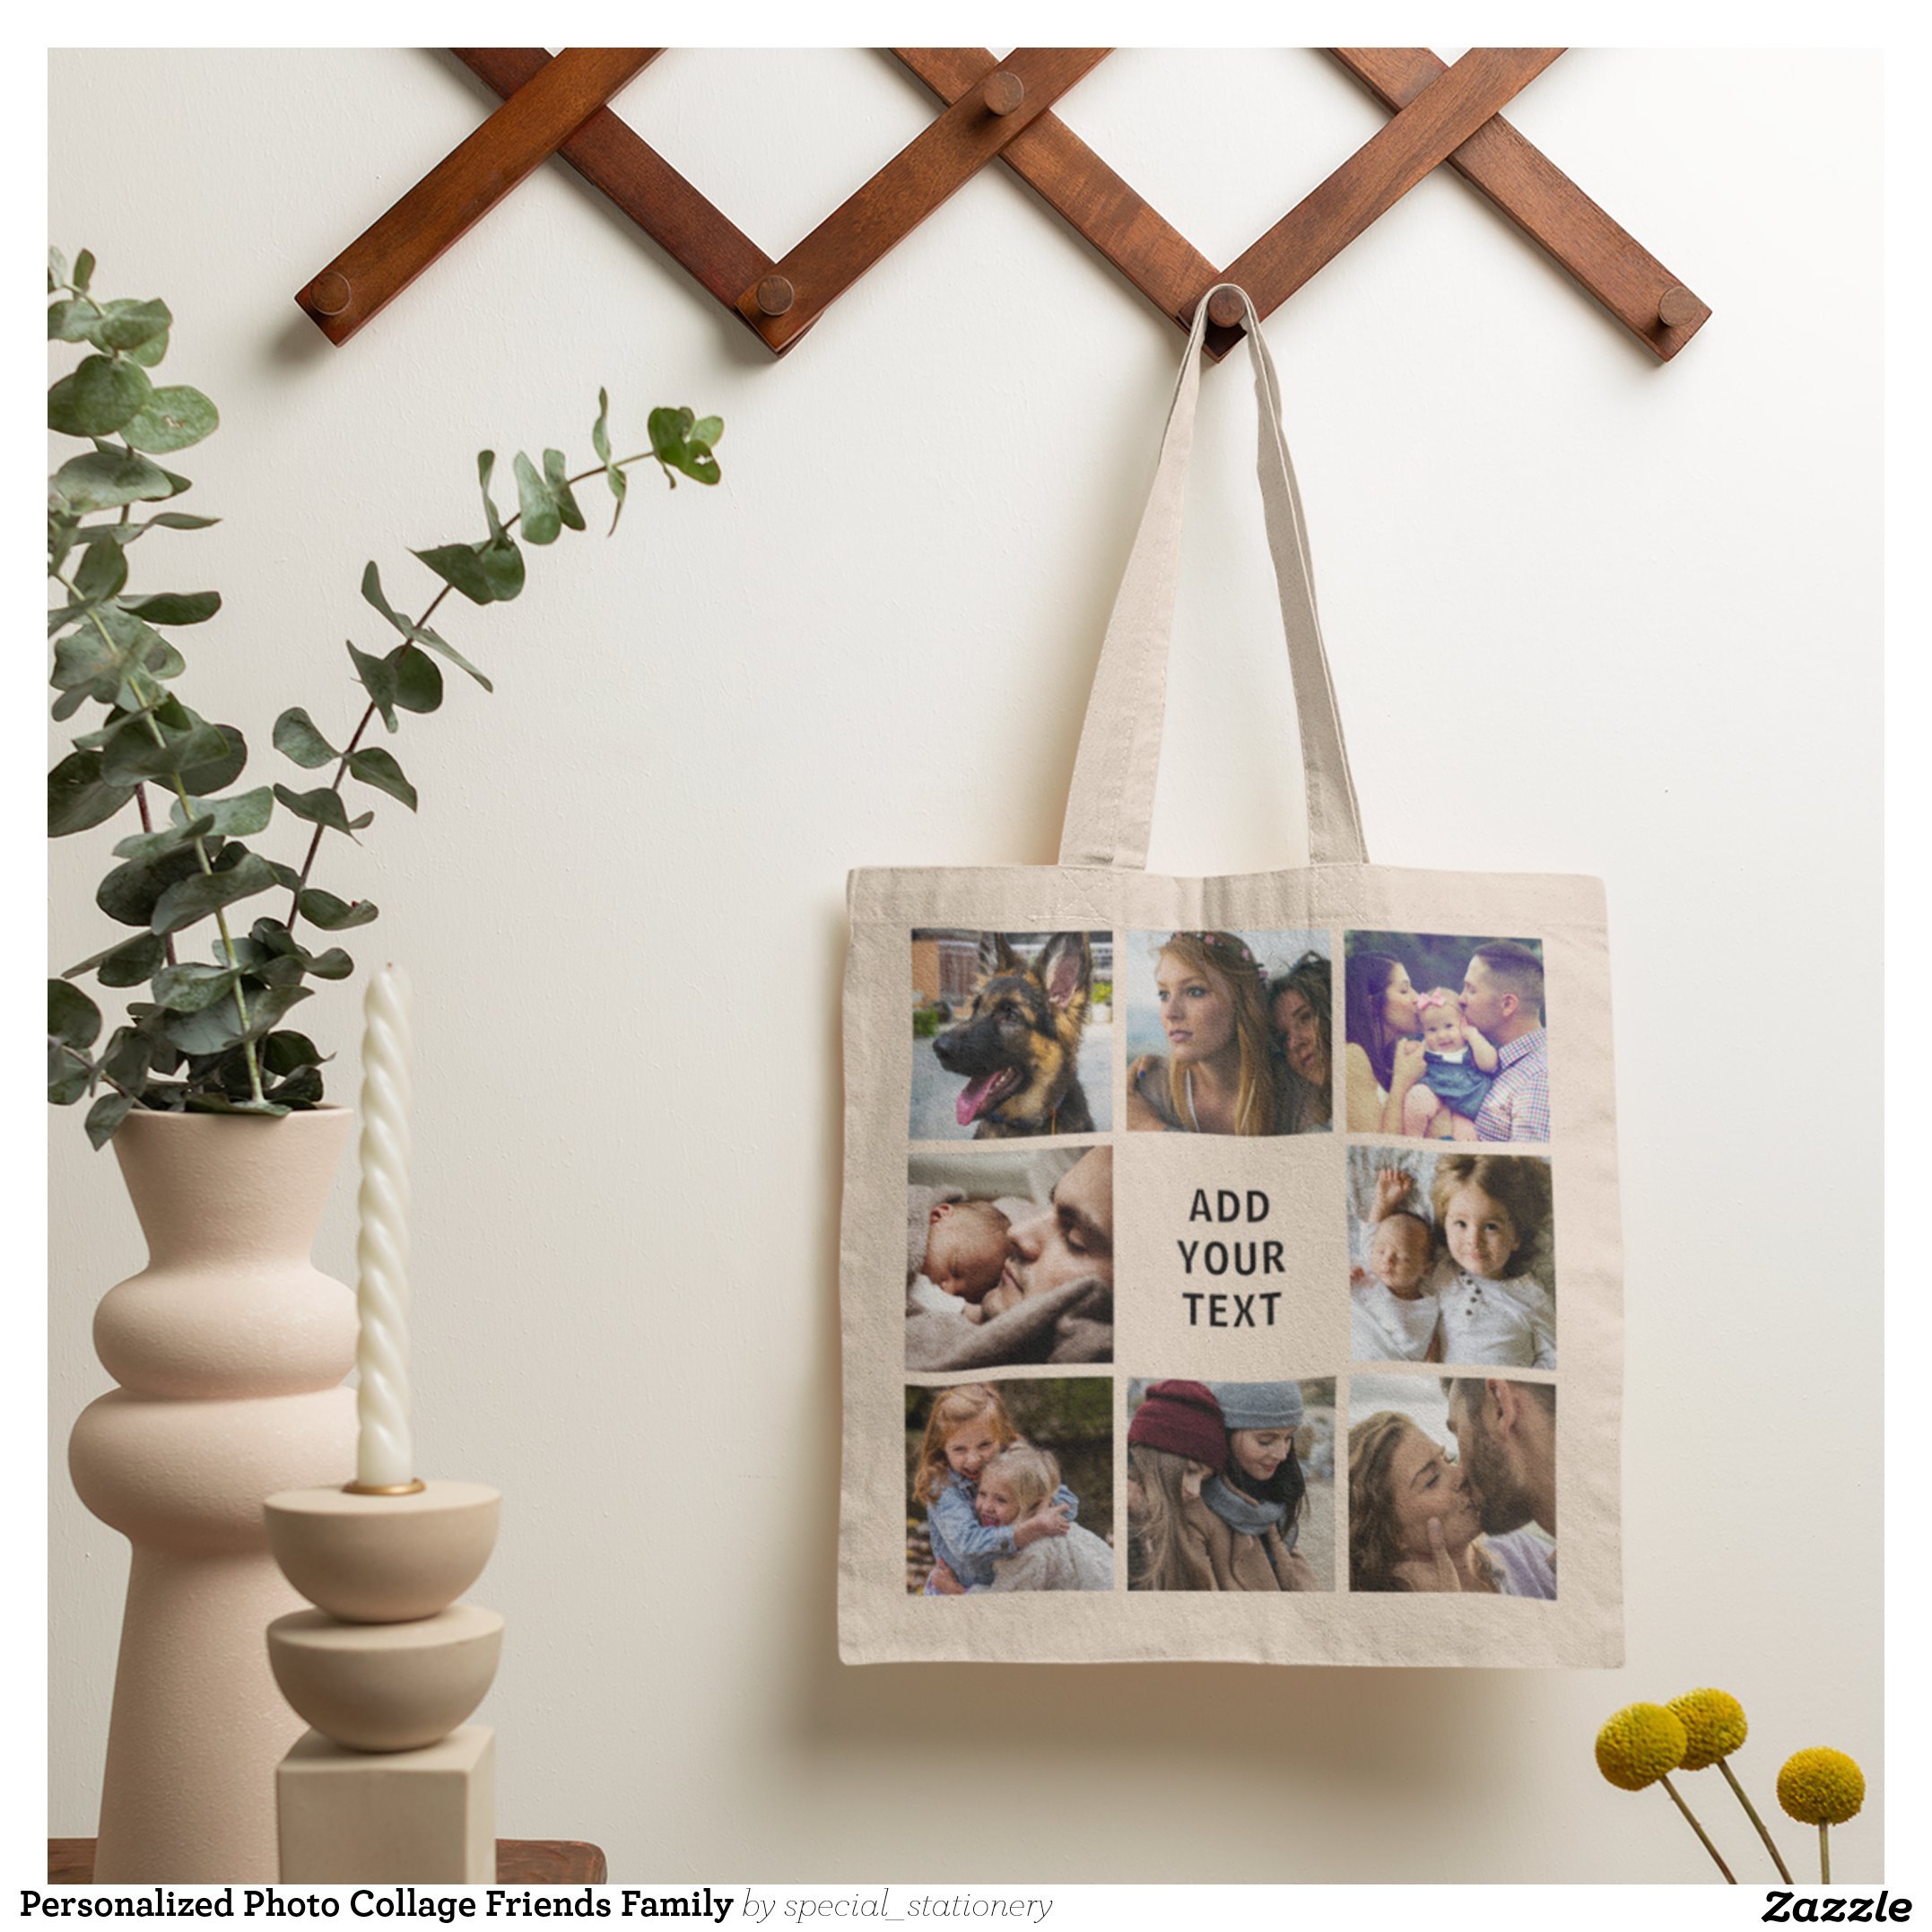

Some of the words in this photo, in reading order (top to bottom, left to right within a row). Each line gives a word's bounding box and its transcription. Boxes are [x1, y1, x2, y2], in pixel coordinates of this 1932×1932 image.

[1189, 1188, 1271, 1224] ADD
[1177, 1240, 1286, 1276] YOUR
[1182, 1292, 1283, 1327] TEXT
